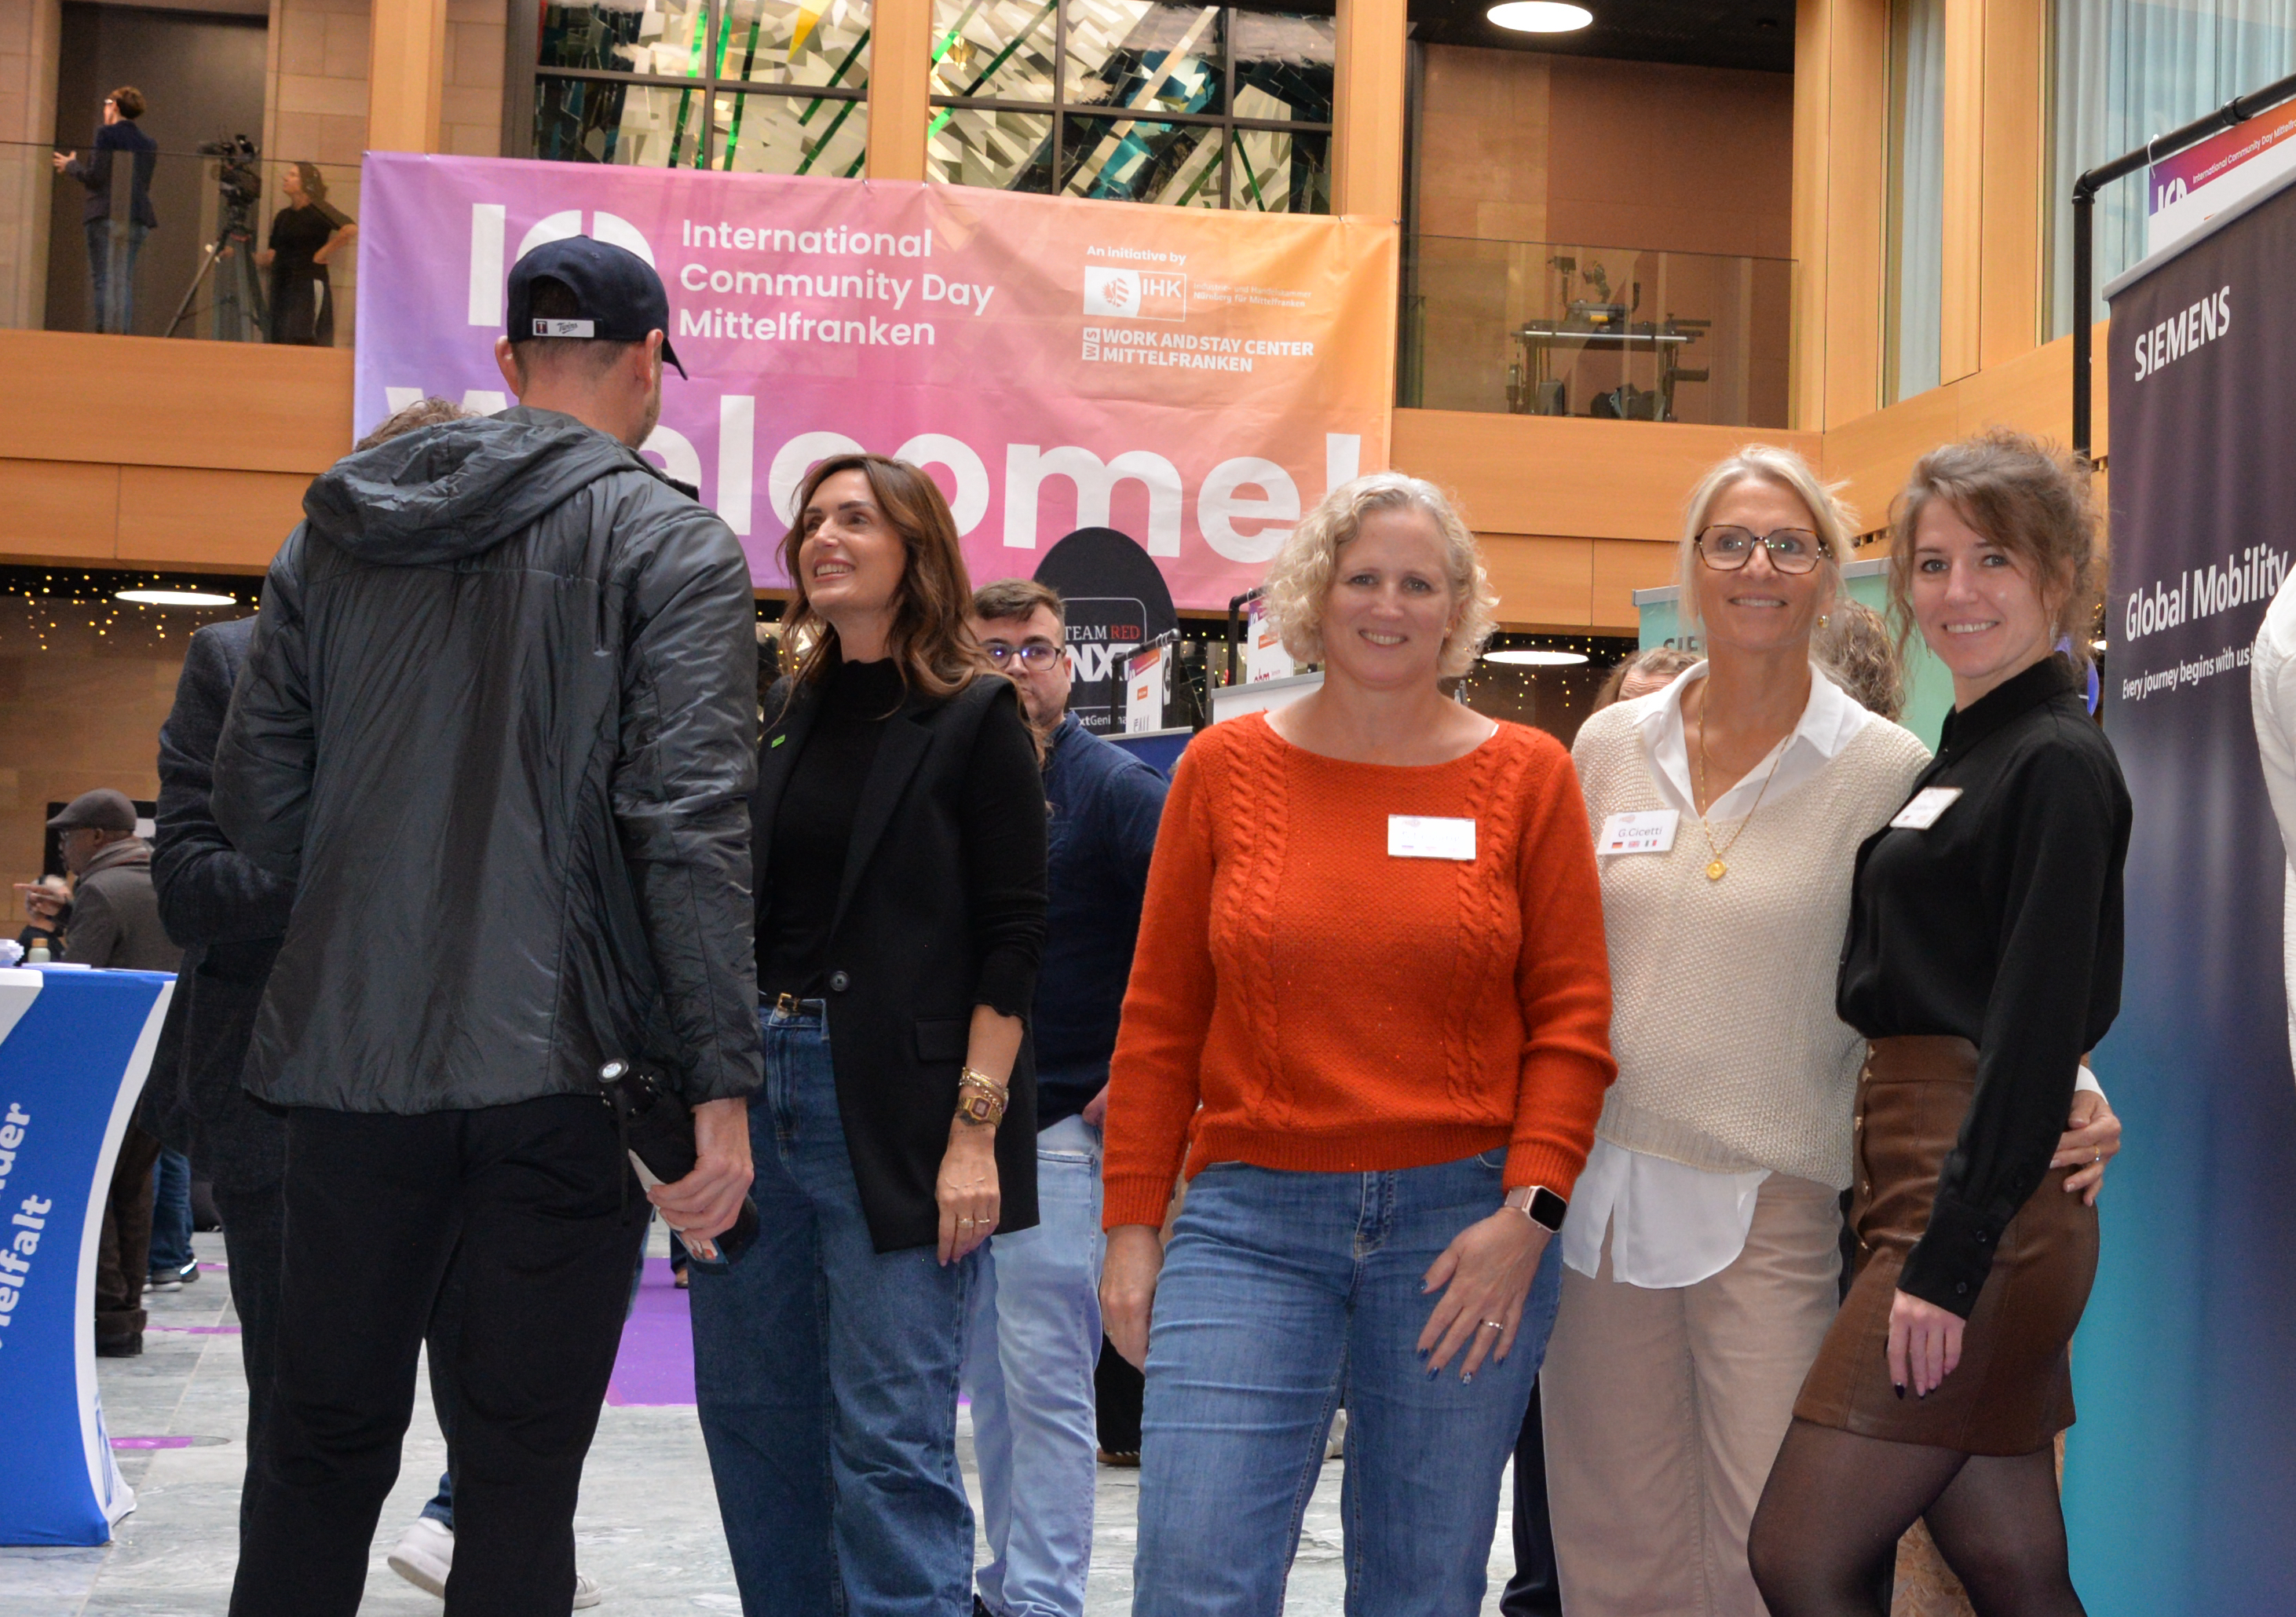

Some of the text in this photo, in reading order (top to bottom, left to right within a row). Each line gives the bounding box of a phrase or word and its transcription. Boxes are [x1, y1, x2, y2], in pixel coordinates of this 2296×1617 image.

[2193, 156, 2228, 184] International
[2228, 140, 2261, 164] Community
[2261, 133, 2273, 145] Day
[682, 219, 932, 257] International
[1087, 246, 1186, 265] An initiative by
[680, 263, 995, 316] Community Day
[1143, 278, 1182, 298] IHK
[1193, 291, 1232, 303] Nürnberg
[1249, 296, 1306, 307] Mittelfranken
[679, 308, 936, 346] Mittelfranken
[1102, 328, 1314, 356] WORK AND STAY CENTER
[2135, 285, 2230, 382] SIEMENS
[1102, 347, 1253, 372] MITTELFRANKEN
[2126, 543, 2288, 642] Global Mobility
[1065, 624, 1141, 640] TEAM RED
[2122, 678, 2144, 701] Every
[2143, 668, 2179, 699] journey
[2180, 654, 2214, 686] begins
[2215, 646, 2235, 673] with
